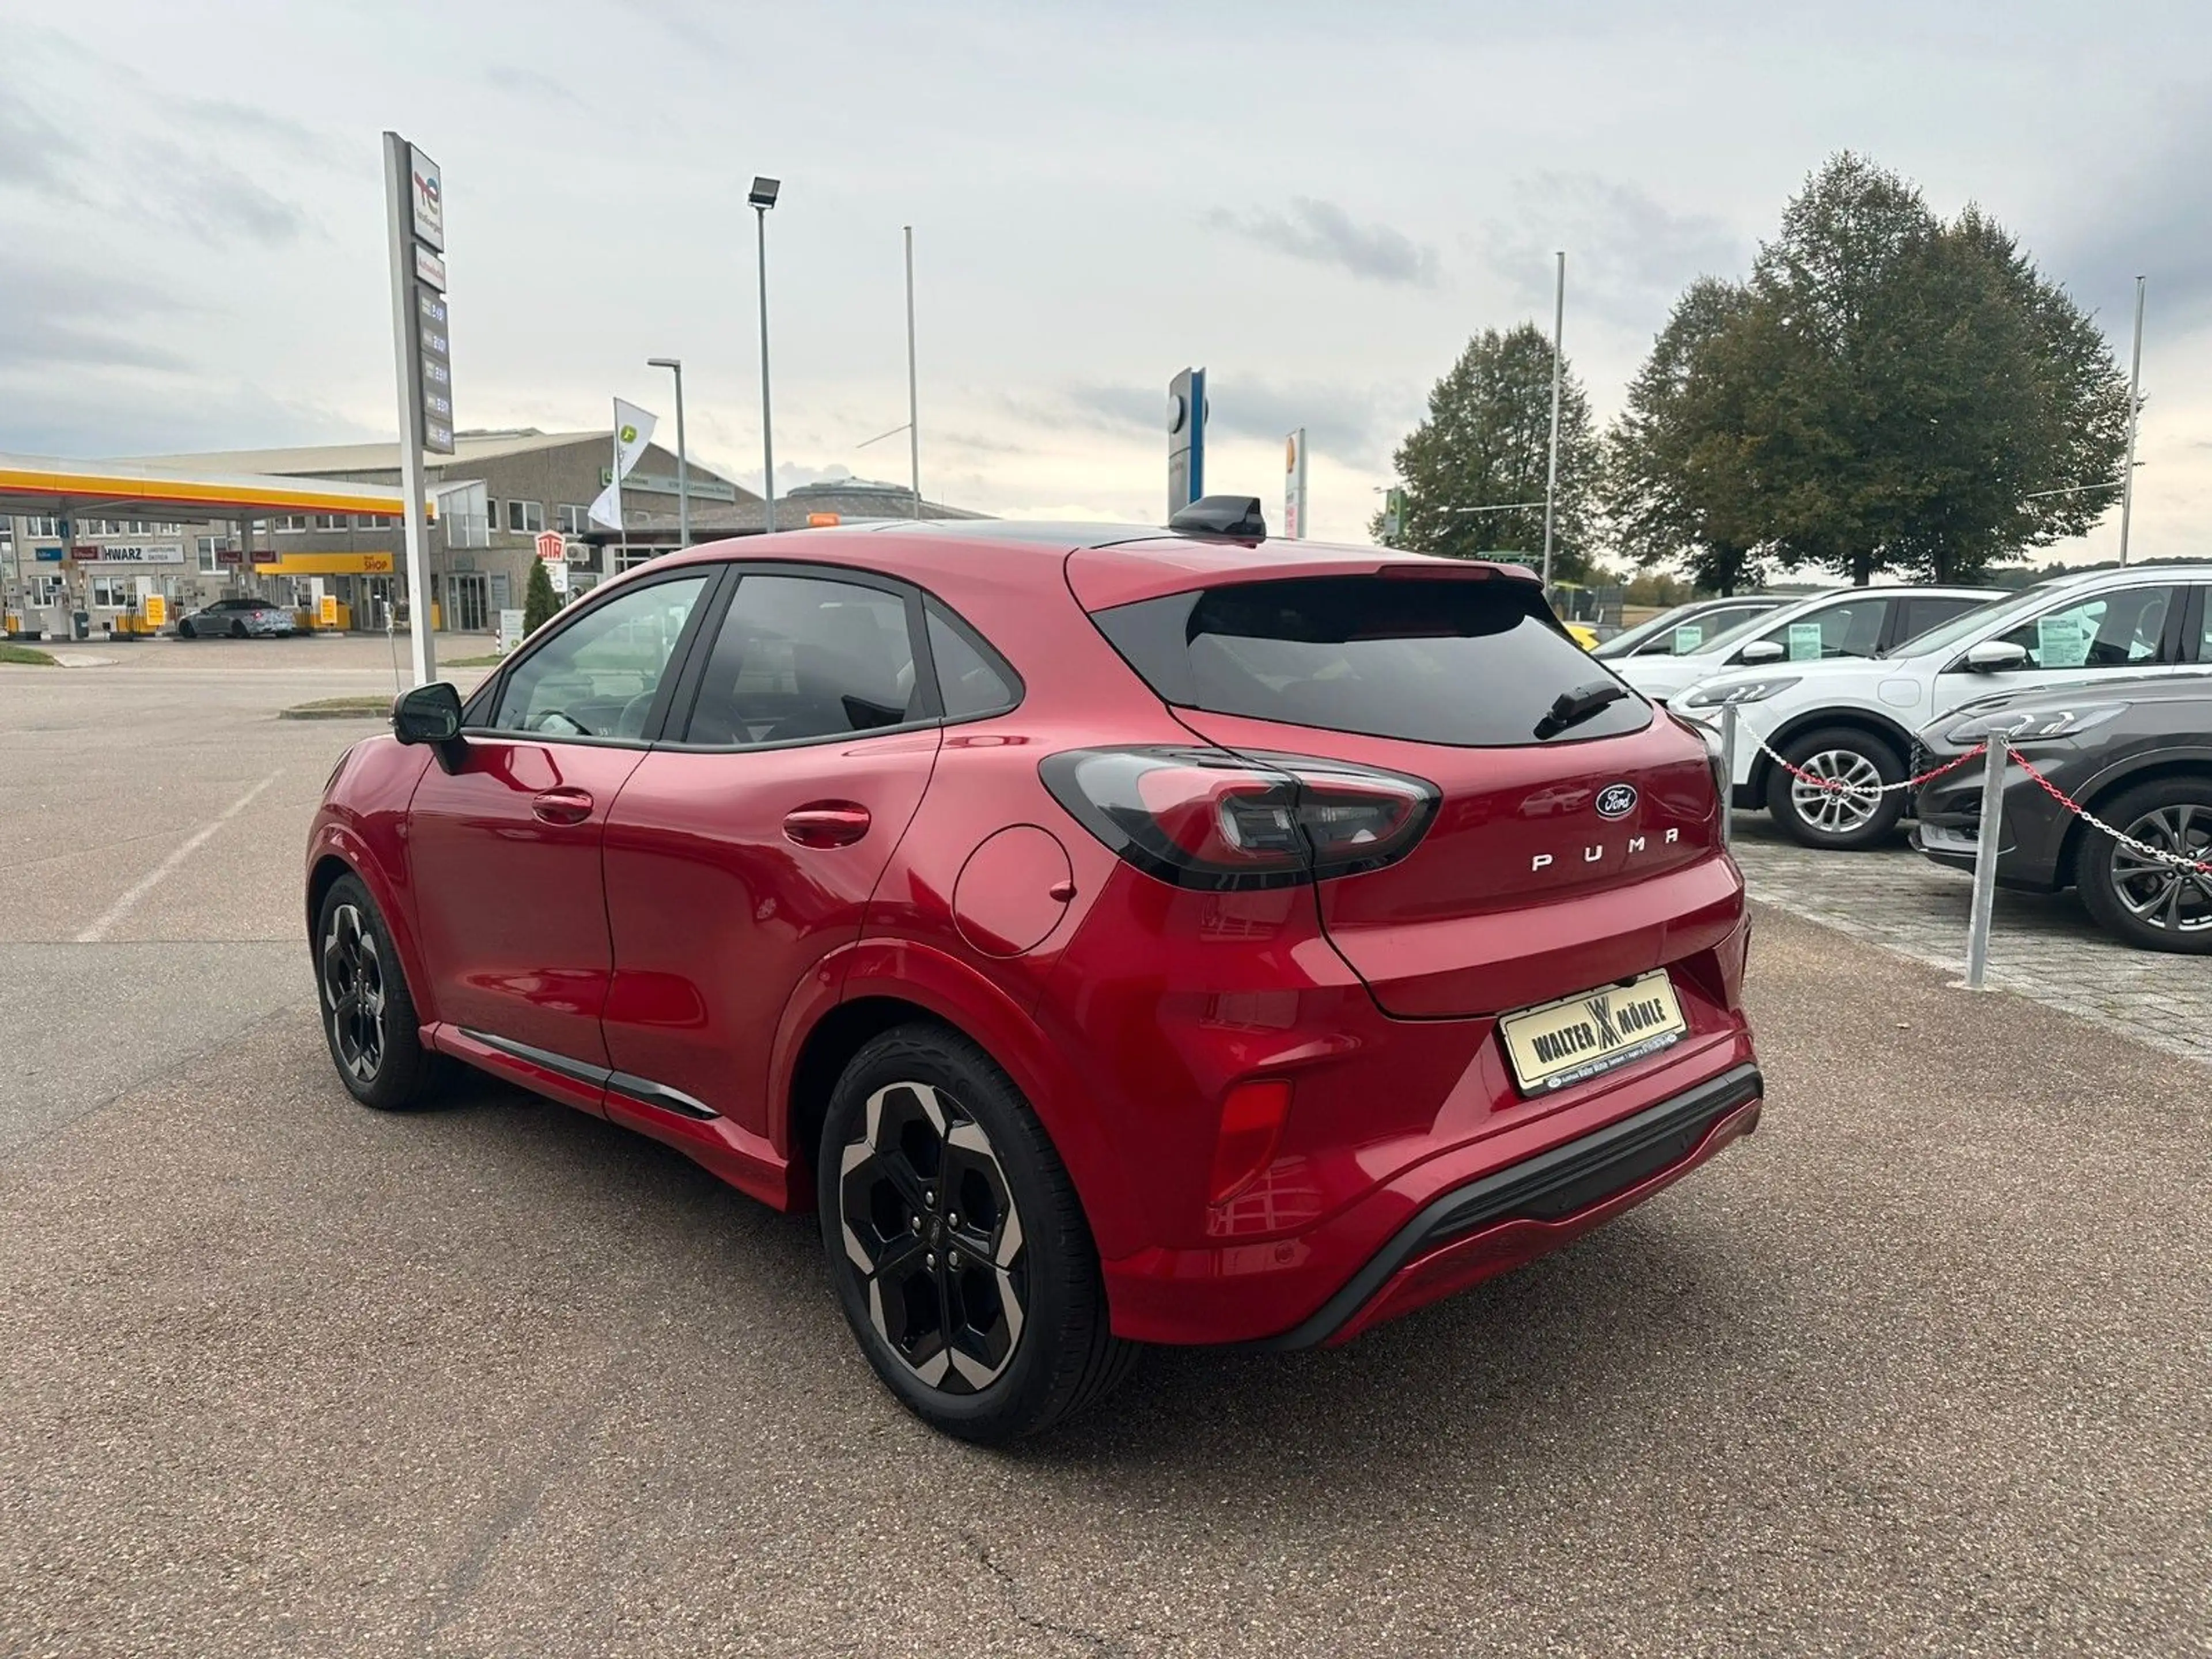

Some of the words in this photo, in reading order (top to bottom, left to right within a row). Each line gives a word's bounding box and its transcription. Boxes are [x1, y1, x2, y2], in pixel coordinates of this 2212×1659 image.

[104, 547, 143, 560] HWARZ
[364, 560, 388, 570] SHOP
[1604, 789, 1632, 810] Ford
[1532, 828, 1679, 871] PUMA
[1532, 1021, 1596, 1064] WALTER
